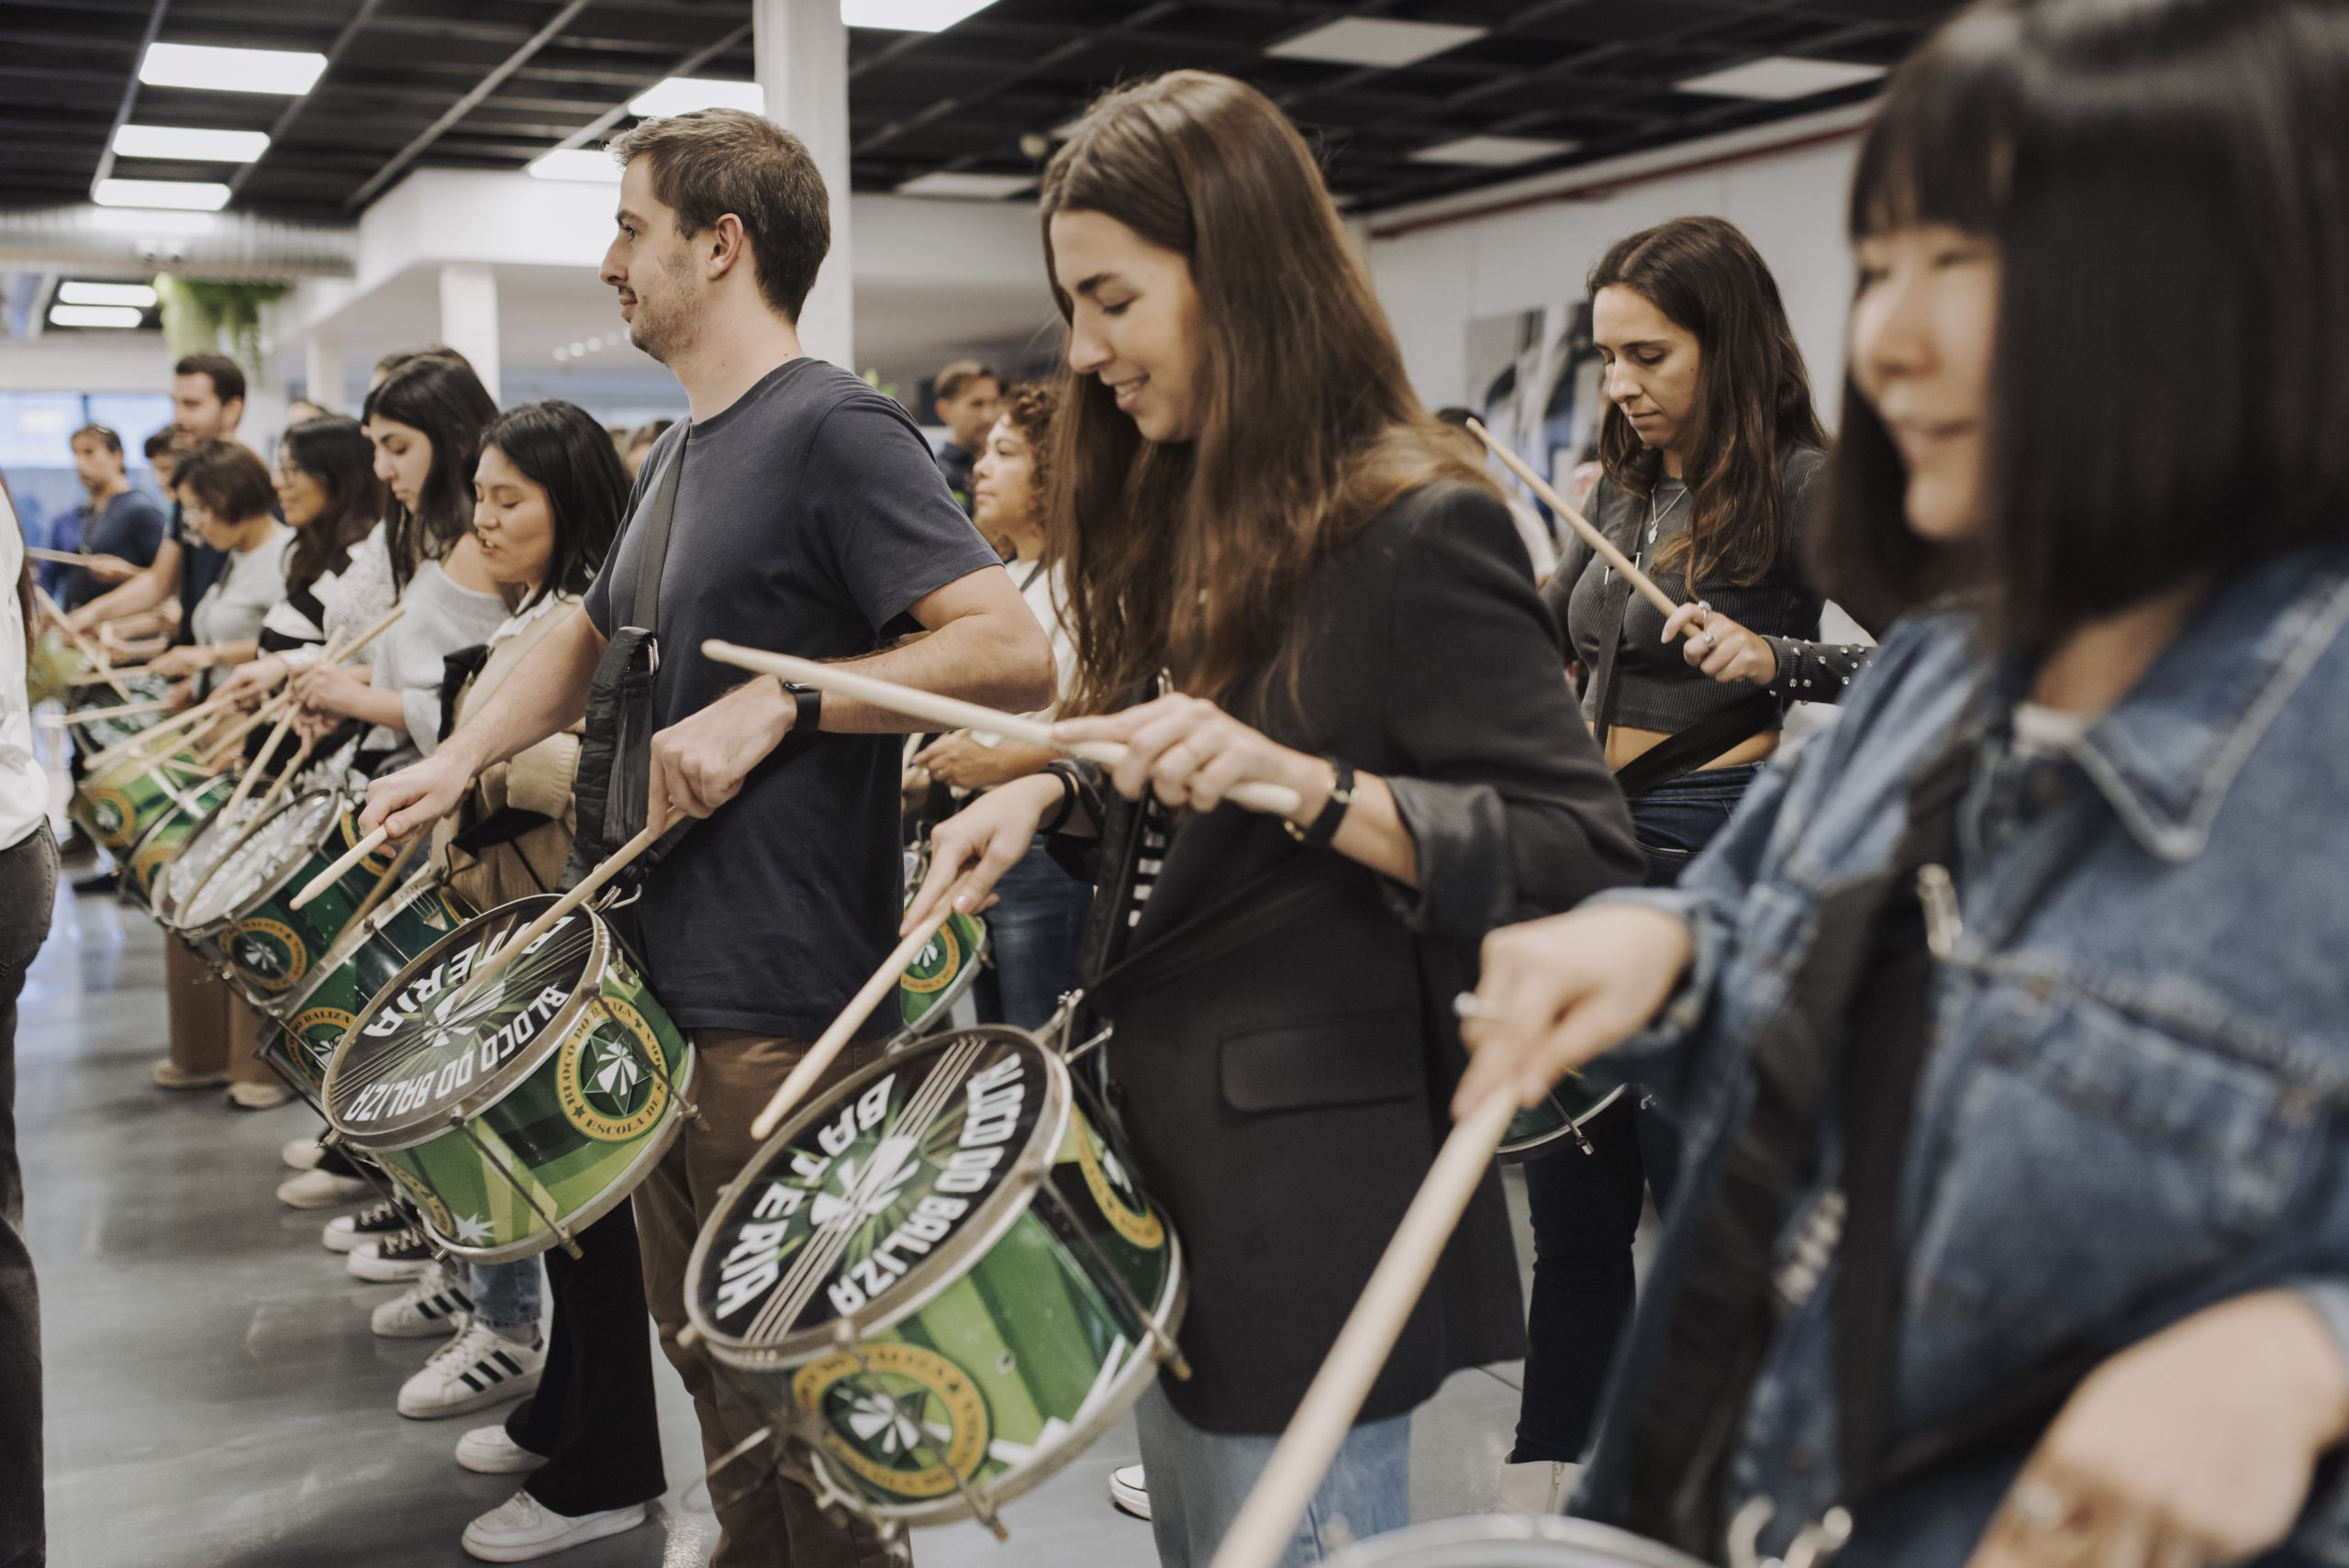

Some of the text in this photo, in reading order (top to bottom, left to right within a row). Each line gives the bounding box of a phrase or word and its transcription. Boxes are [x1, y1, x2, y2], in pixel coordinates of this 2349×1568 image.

[362, 916, 576, 1037] BTERIA
[342, 985, 570, 1122] BLOCO DO BALIZA
[562, 1043, 576, 1106] BLOCO
[573, 1018, 590, 1040] DO
[584, 1118, 645, 1135] ESCOLA
[646, 1097, 659, 1118] DE
[934, 1146, 1006, 1193] DO
[715, 1072, 897, 1320] BATERIA
[827, 1194, 970, 1318] BALIZA
